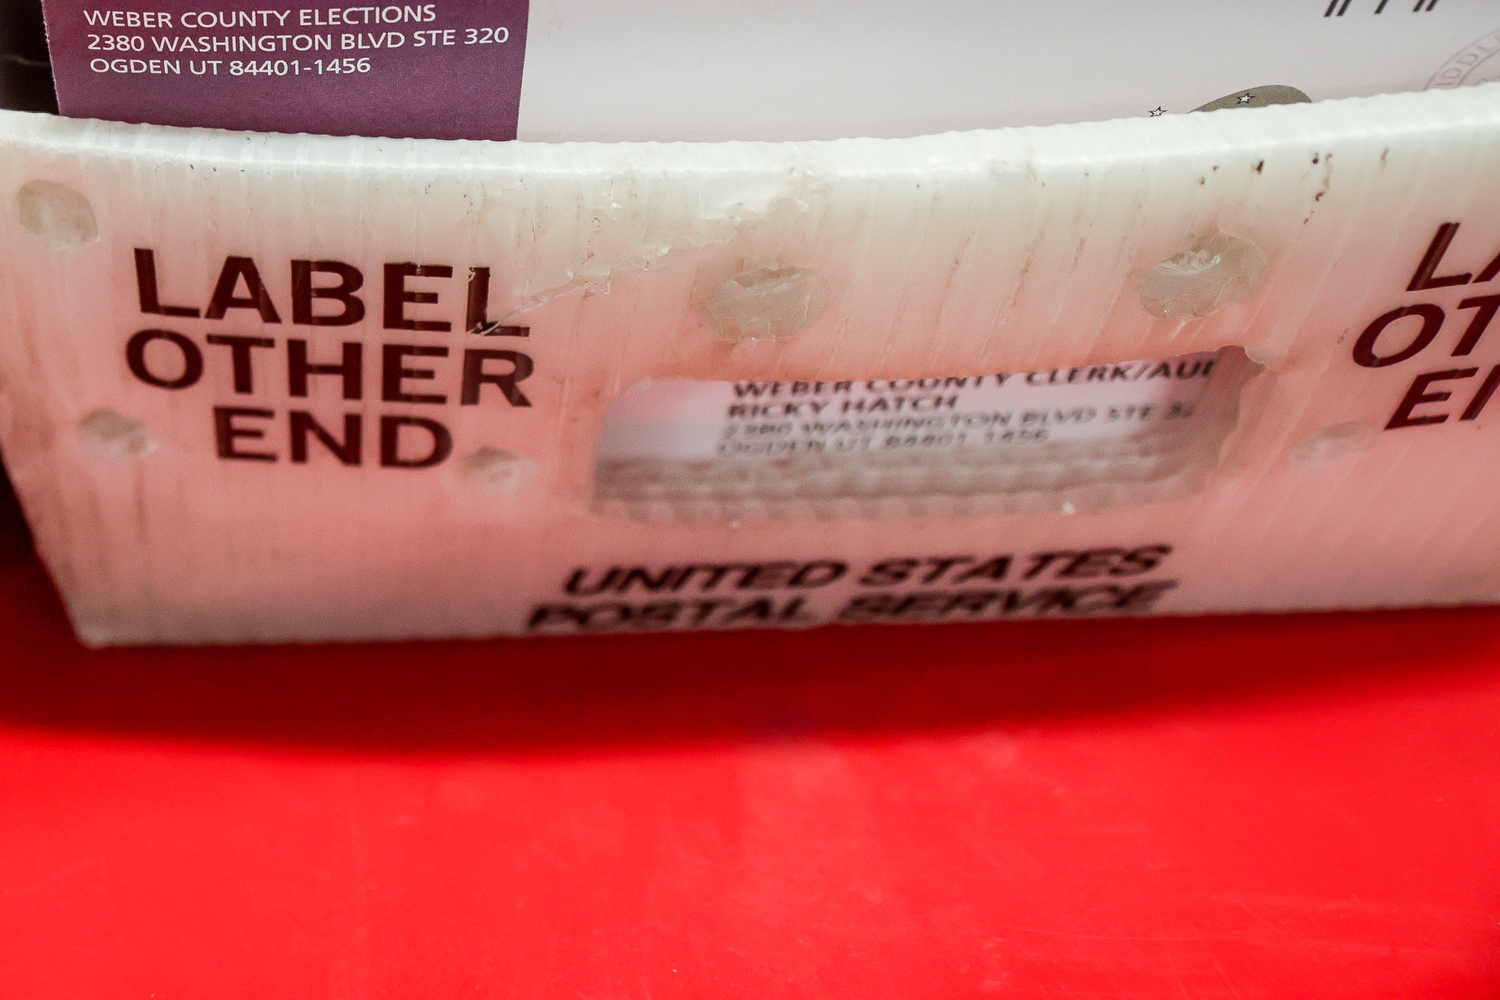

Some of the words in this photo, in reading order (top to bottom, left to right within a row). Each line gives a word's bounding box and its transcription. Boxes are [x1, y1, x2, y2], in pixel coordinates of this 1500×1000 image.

[84, 9, 173, 29] WEBER
[181, 9, 291, 28] COUNTY
[300, 4, 436, 26] ELECTIONS
[87, 34, 145, 52] 2380
[151, 33, 331, 53] WASHINGTON
[341, 31, 405, 50] BLVD
[413, 29, 456, 47] STE
[465, 26, 510, 45] 320
[90, 58, 181, 75] OGDEN
[190, 59, 222, 76] UT
[229, 57, 371, 77] 84401-1456
[133, 247, 532, 338] LABEL
[125, 328, 535, 408] OTHER
[728, 400, 828, 418] RICKY
[841, 394, 958, 415] HATCH
[733, 380, 853, 398] WEBER
[213, 406, 454, 470] END
[562, 559, 849, 597] UNITED
[857, 543, 1174, 587] STATES
[525, 595, 812, 632] POSTAL
[833, 578, 1182, 624] SERVICE
